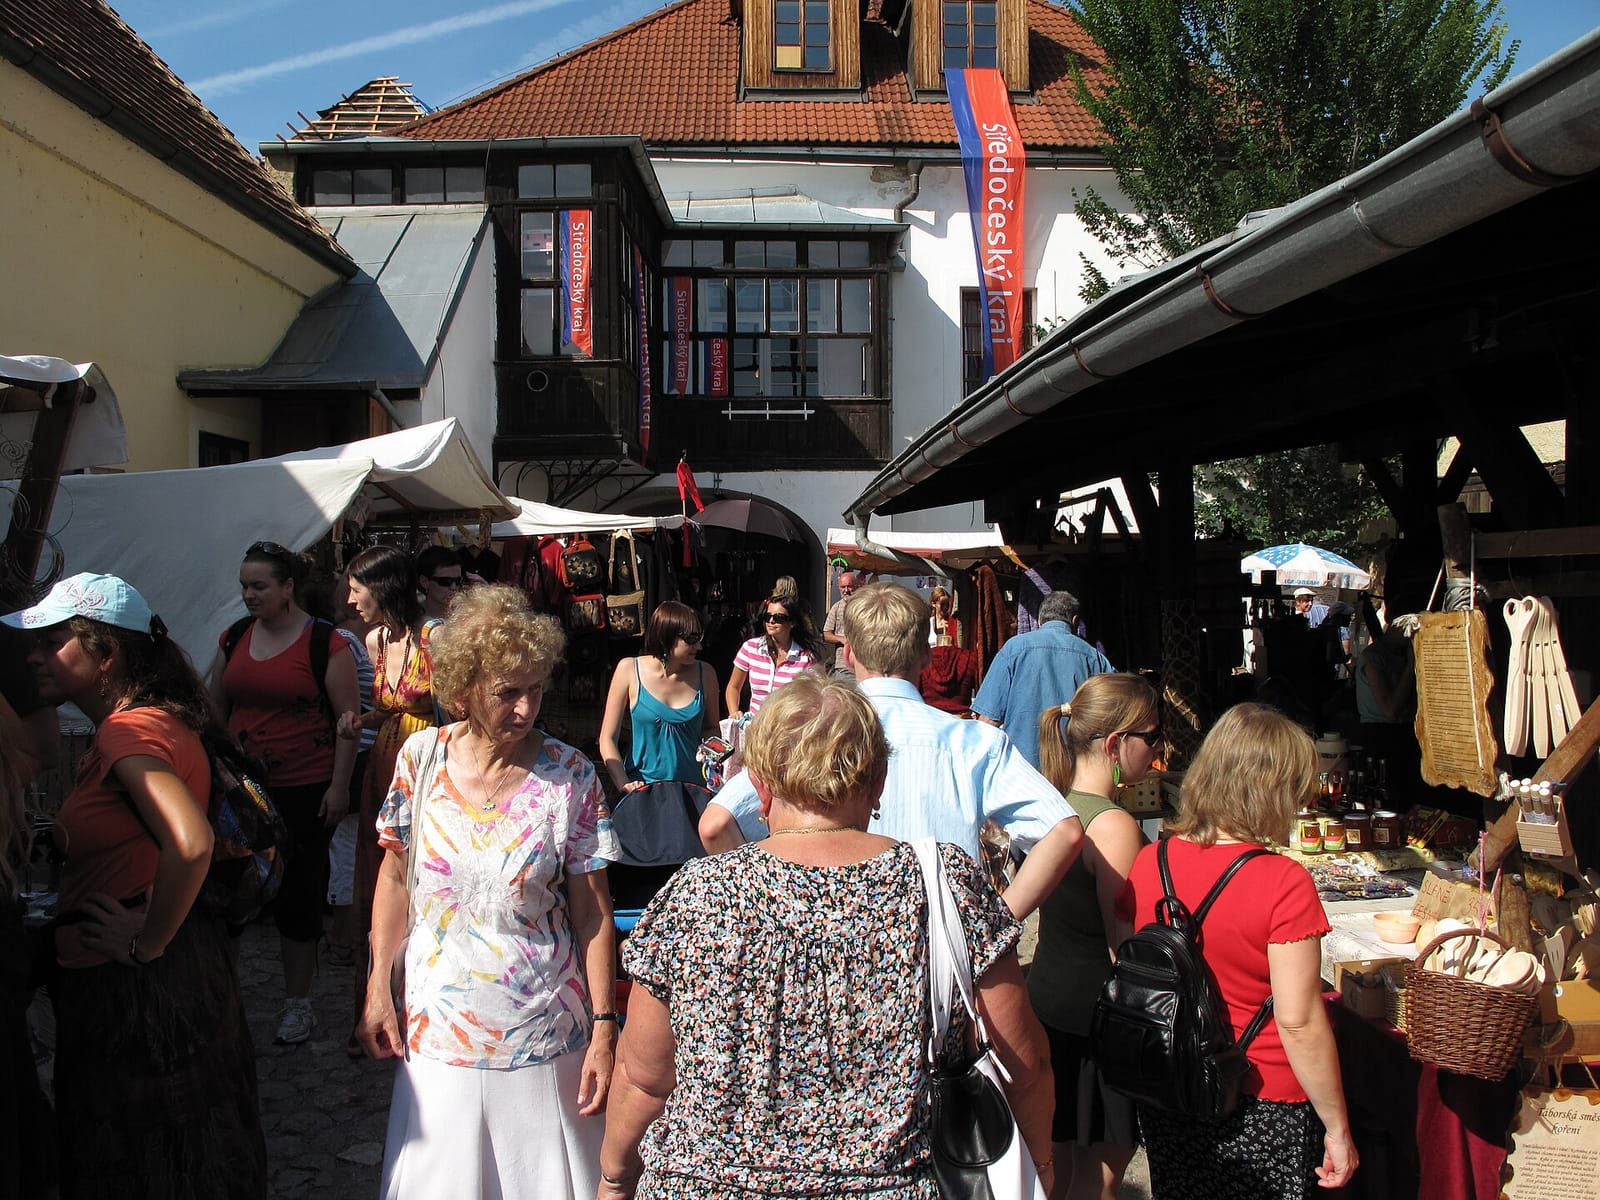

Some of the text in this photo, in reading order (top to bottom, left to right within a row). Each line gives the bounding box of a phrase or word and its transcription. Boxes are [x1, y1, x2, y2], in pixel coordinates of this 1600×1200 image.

[982, 123, 1014, 282] Středočeský
[571, 222, 586, 333] Středočeský kraj
[675, 290, 689, 383] Středočeský kraj
[712, 370, 724, 391] kraj
[1422, 880, 1452, 903] SLANÉ
[1552, 1122, 1582, 1136] koření
